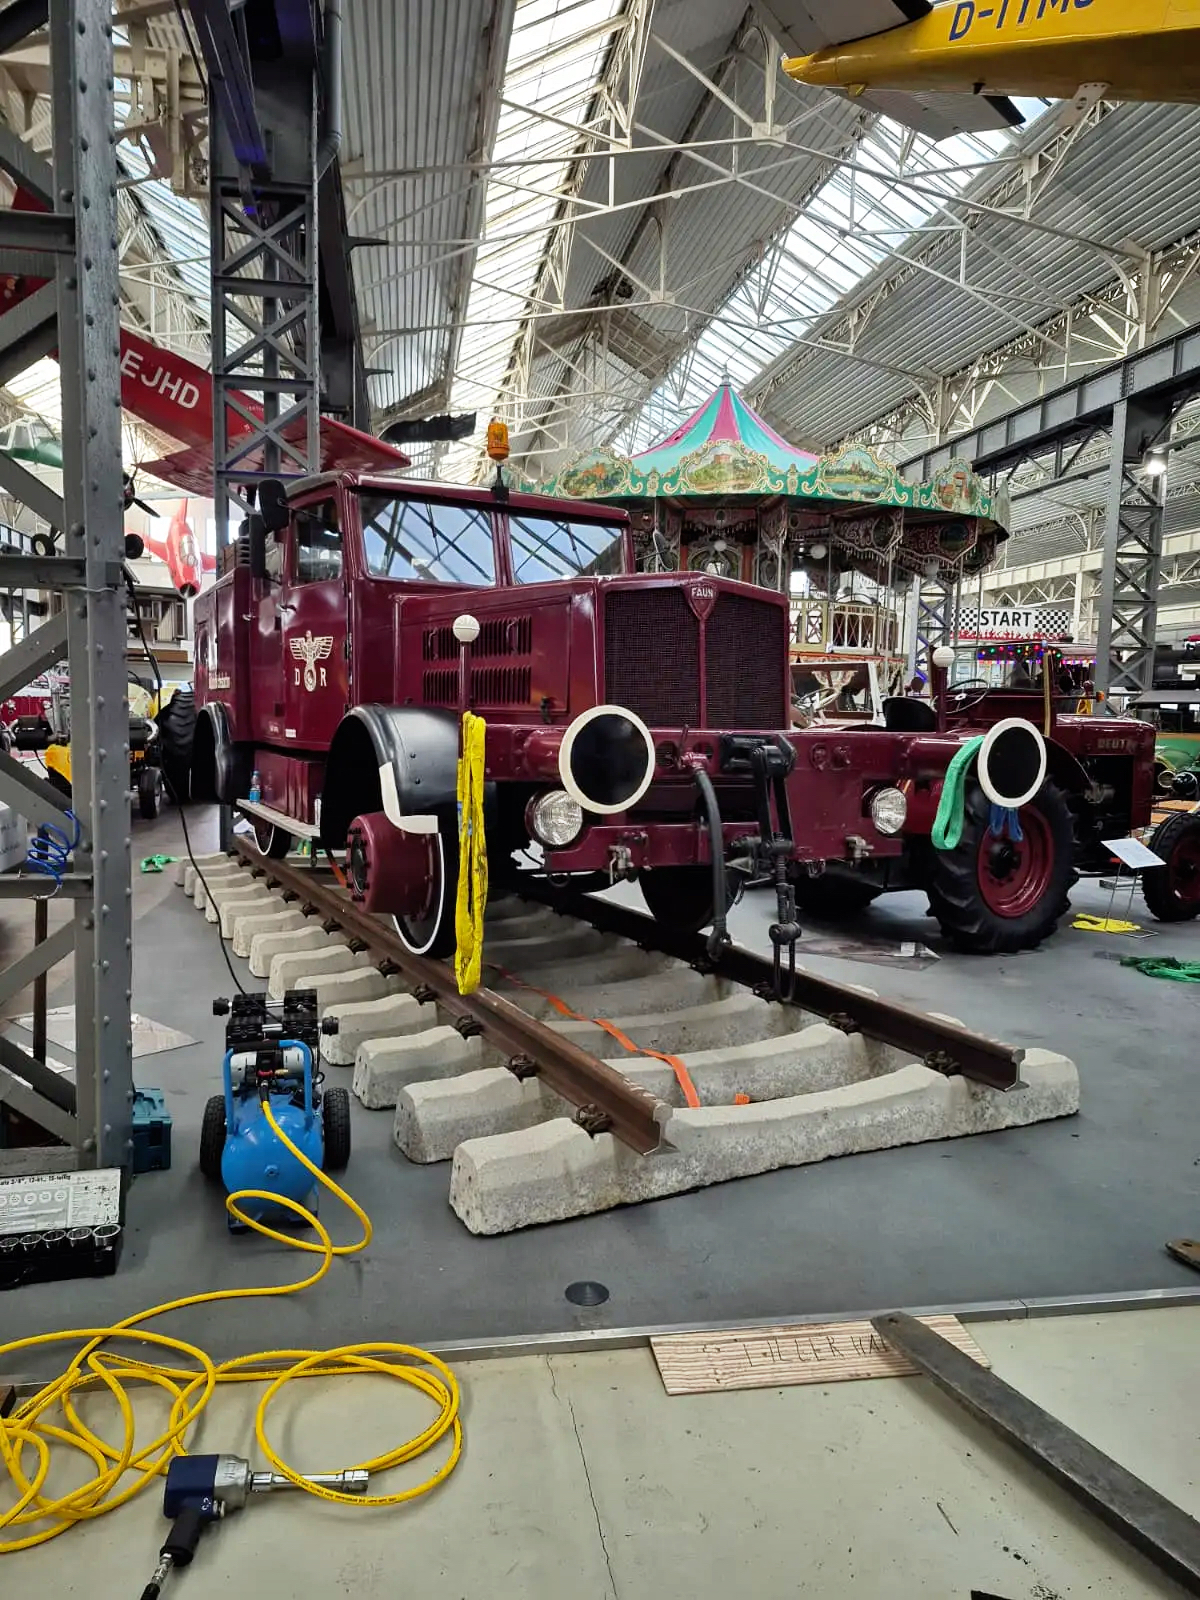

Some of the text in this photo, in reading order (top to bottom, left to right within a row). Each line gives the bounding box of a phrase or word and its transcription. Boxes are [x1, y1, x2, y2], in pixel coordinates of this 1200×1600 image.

[949, 0, 1093, 41] D-ITM
[120, 349, 200, 409] EJHD
[691, 587, 713, 598] FAUN
[980, 610, 1032, 627] START
[294, 667, 327, 687] D R
